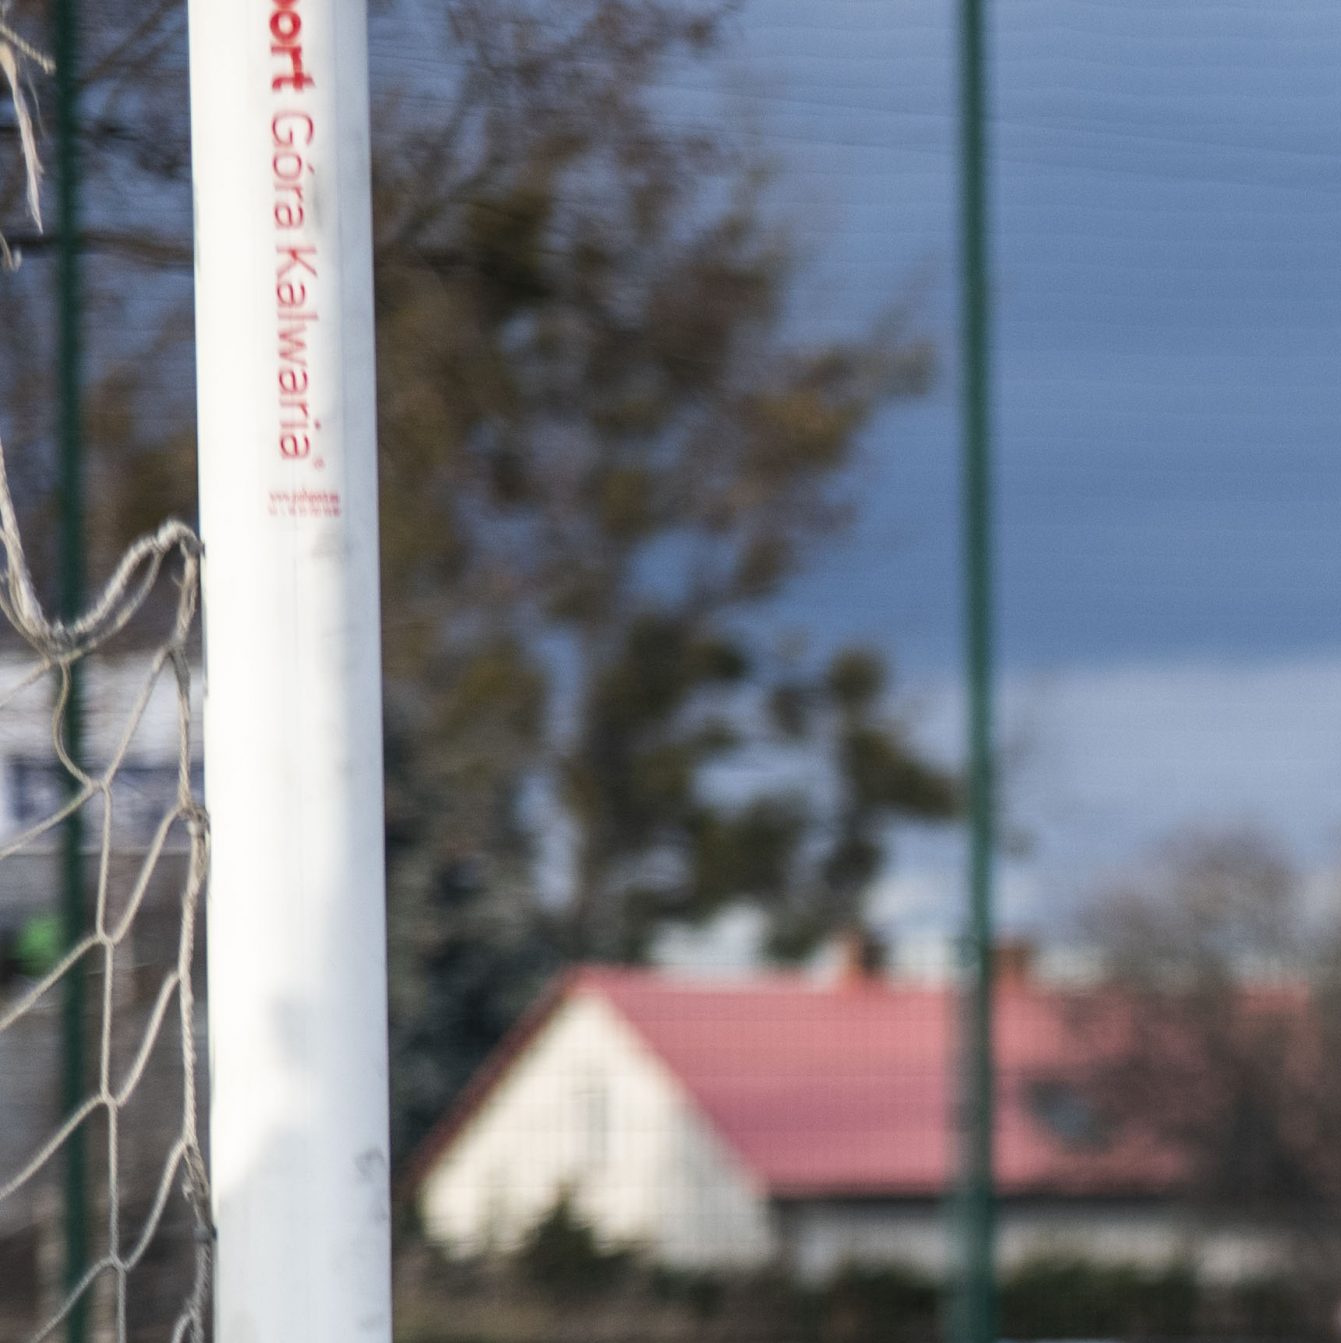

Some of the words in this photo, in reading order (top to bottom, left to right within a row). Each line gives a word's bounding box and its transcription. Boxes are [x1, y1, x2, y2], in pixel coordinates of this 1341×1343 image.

[270, 0, 316, 91] ort
[272, 110, 315, 229] Góra
[276, 246, 321, 459] Kalwaria
